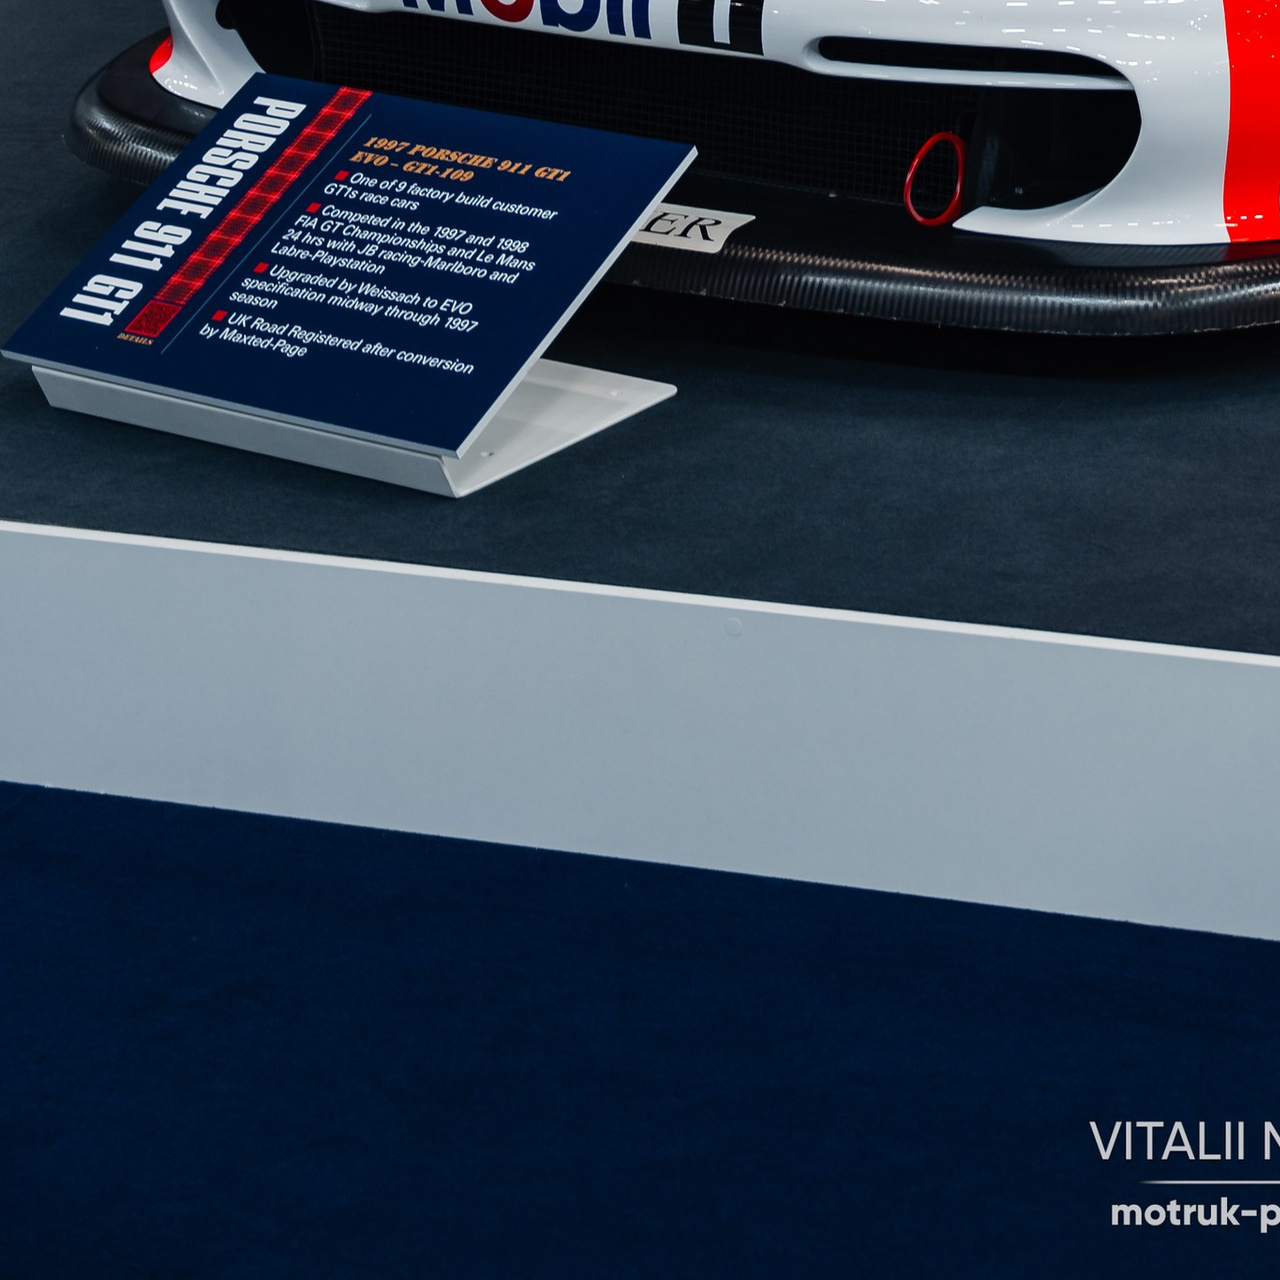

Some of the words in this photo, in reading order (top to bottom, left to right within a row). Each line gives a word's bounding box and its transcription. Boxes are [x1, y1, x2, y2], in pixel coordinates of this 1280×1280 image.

[156, 96, 307, 220] PORSCHE
[349, 151, 391, 168] EVO
[402, 160, 475, 183] GT1-109
[363, 136, 408, 155] 1997
[408, 144, 498, 170] PORSCHE
[496, 159, 533, 176] 911
[534, 166, 572, 183] GT1
[323, 183, 358, 200] GT1s
[359, 191, 390, 206] race
[390, 197, 420, 212] cars
[350, 172, 378, 188] One
[379, 176, 397, 192] of
[396, 181, 407, 194] 9
[406, 181, 455, 204] factory
[455, 189, 492, 209] build
[492, 199, 558, 221] customer
[109, 220, 192, 272] 911
[294, 214, 319, 231] FIA
[320, 220, 344, 235] GT
[342, 222, 447, 257] Championships
[447, 244, 478, 263] and
[476, 250, 495, 266] Le
[495, 254, 537, 273] Mans
[321, 204, 392, 230] Competed
[391, 216, 406, 231] in
[407, 220, 431, 236] the
[433, 225, 467, 243] 1997
[466, 231, 497, 249] and
[497, 236, 530, 254] 1998
[270, 241, 387, 275] Labre-Playstation
[282, 227, 303, 243] 24
[303, 231, 326, 248] hrs
[326, 237, 357, 254] with
[357, 243, 379, 259] JB
[377, 248, 489, 279] racing-Marlboro
[488, 266, 520, 285] and
[59, 273, 143, 327] GT1
[228, 291, 279, 311] season
[240, 276, 324, 304] specification
[327, 292, 385, 318] midway
[384, 304, 442, 330] through
[444, 315, 480, 334] 1997
[269, 264, 336, 290] Upgraded
[337, 278, 358, 295] by
[357, 282, 422, 307] Weissach
[422, 296, 439, 310] to
[439, 298, 473, 316] EVO
[199, 322, 219, 340] by
[218, 326, 309, 359] Maxted-Page
[227, 311, 251, 328] UK
[250, 316, 288, 336] Road
[287, 324, 362, 354] Registered
[361, 340, 396, 359] after
[396, 346, 475, 376] conversion
